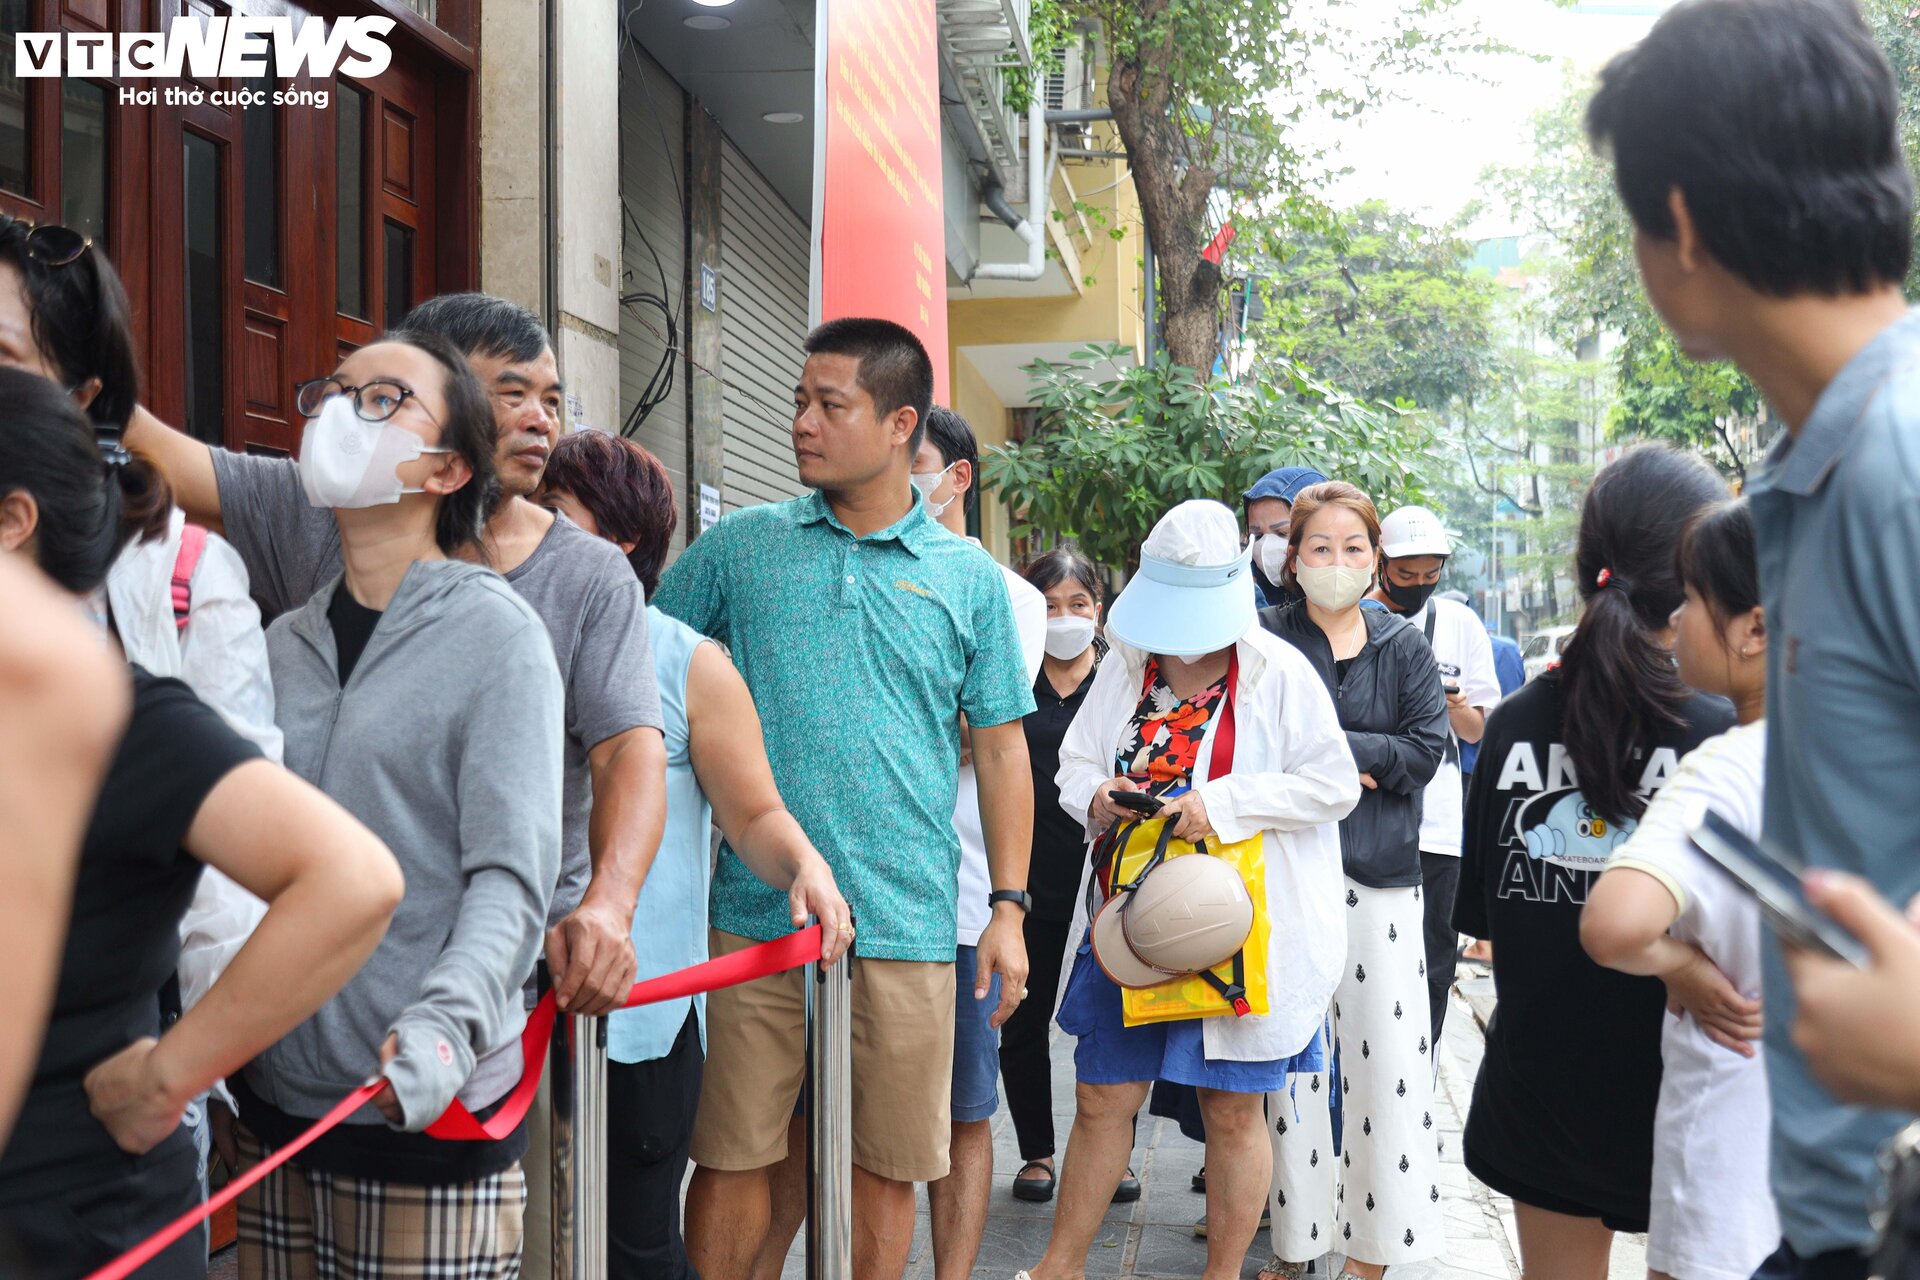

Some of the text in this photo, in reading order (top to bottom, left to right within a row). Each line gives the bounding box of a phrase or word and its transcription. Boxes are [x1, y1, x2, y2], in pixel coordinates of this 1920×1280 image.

[1497, 742, 1680, 796] ANA
[1497, 851, 1590, 904] AN
[1557, 855, 1609, 865] SKATEBOAR
